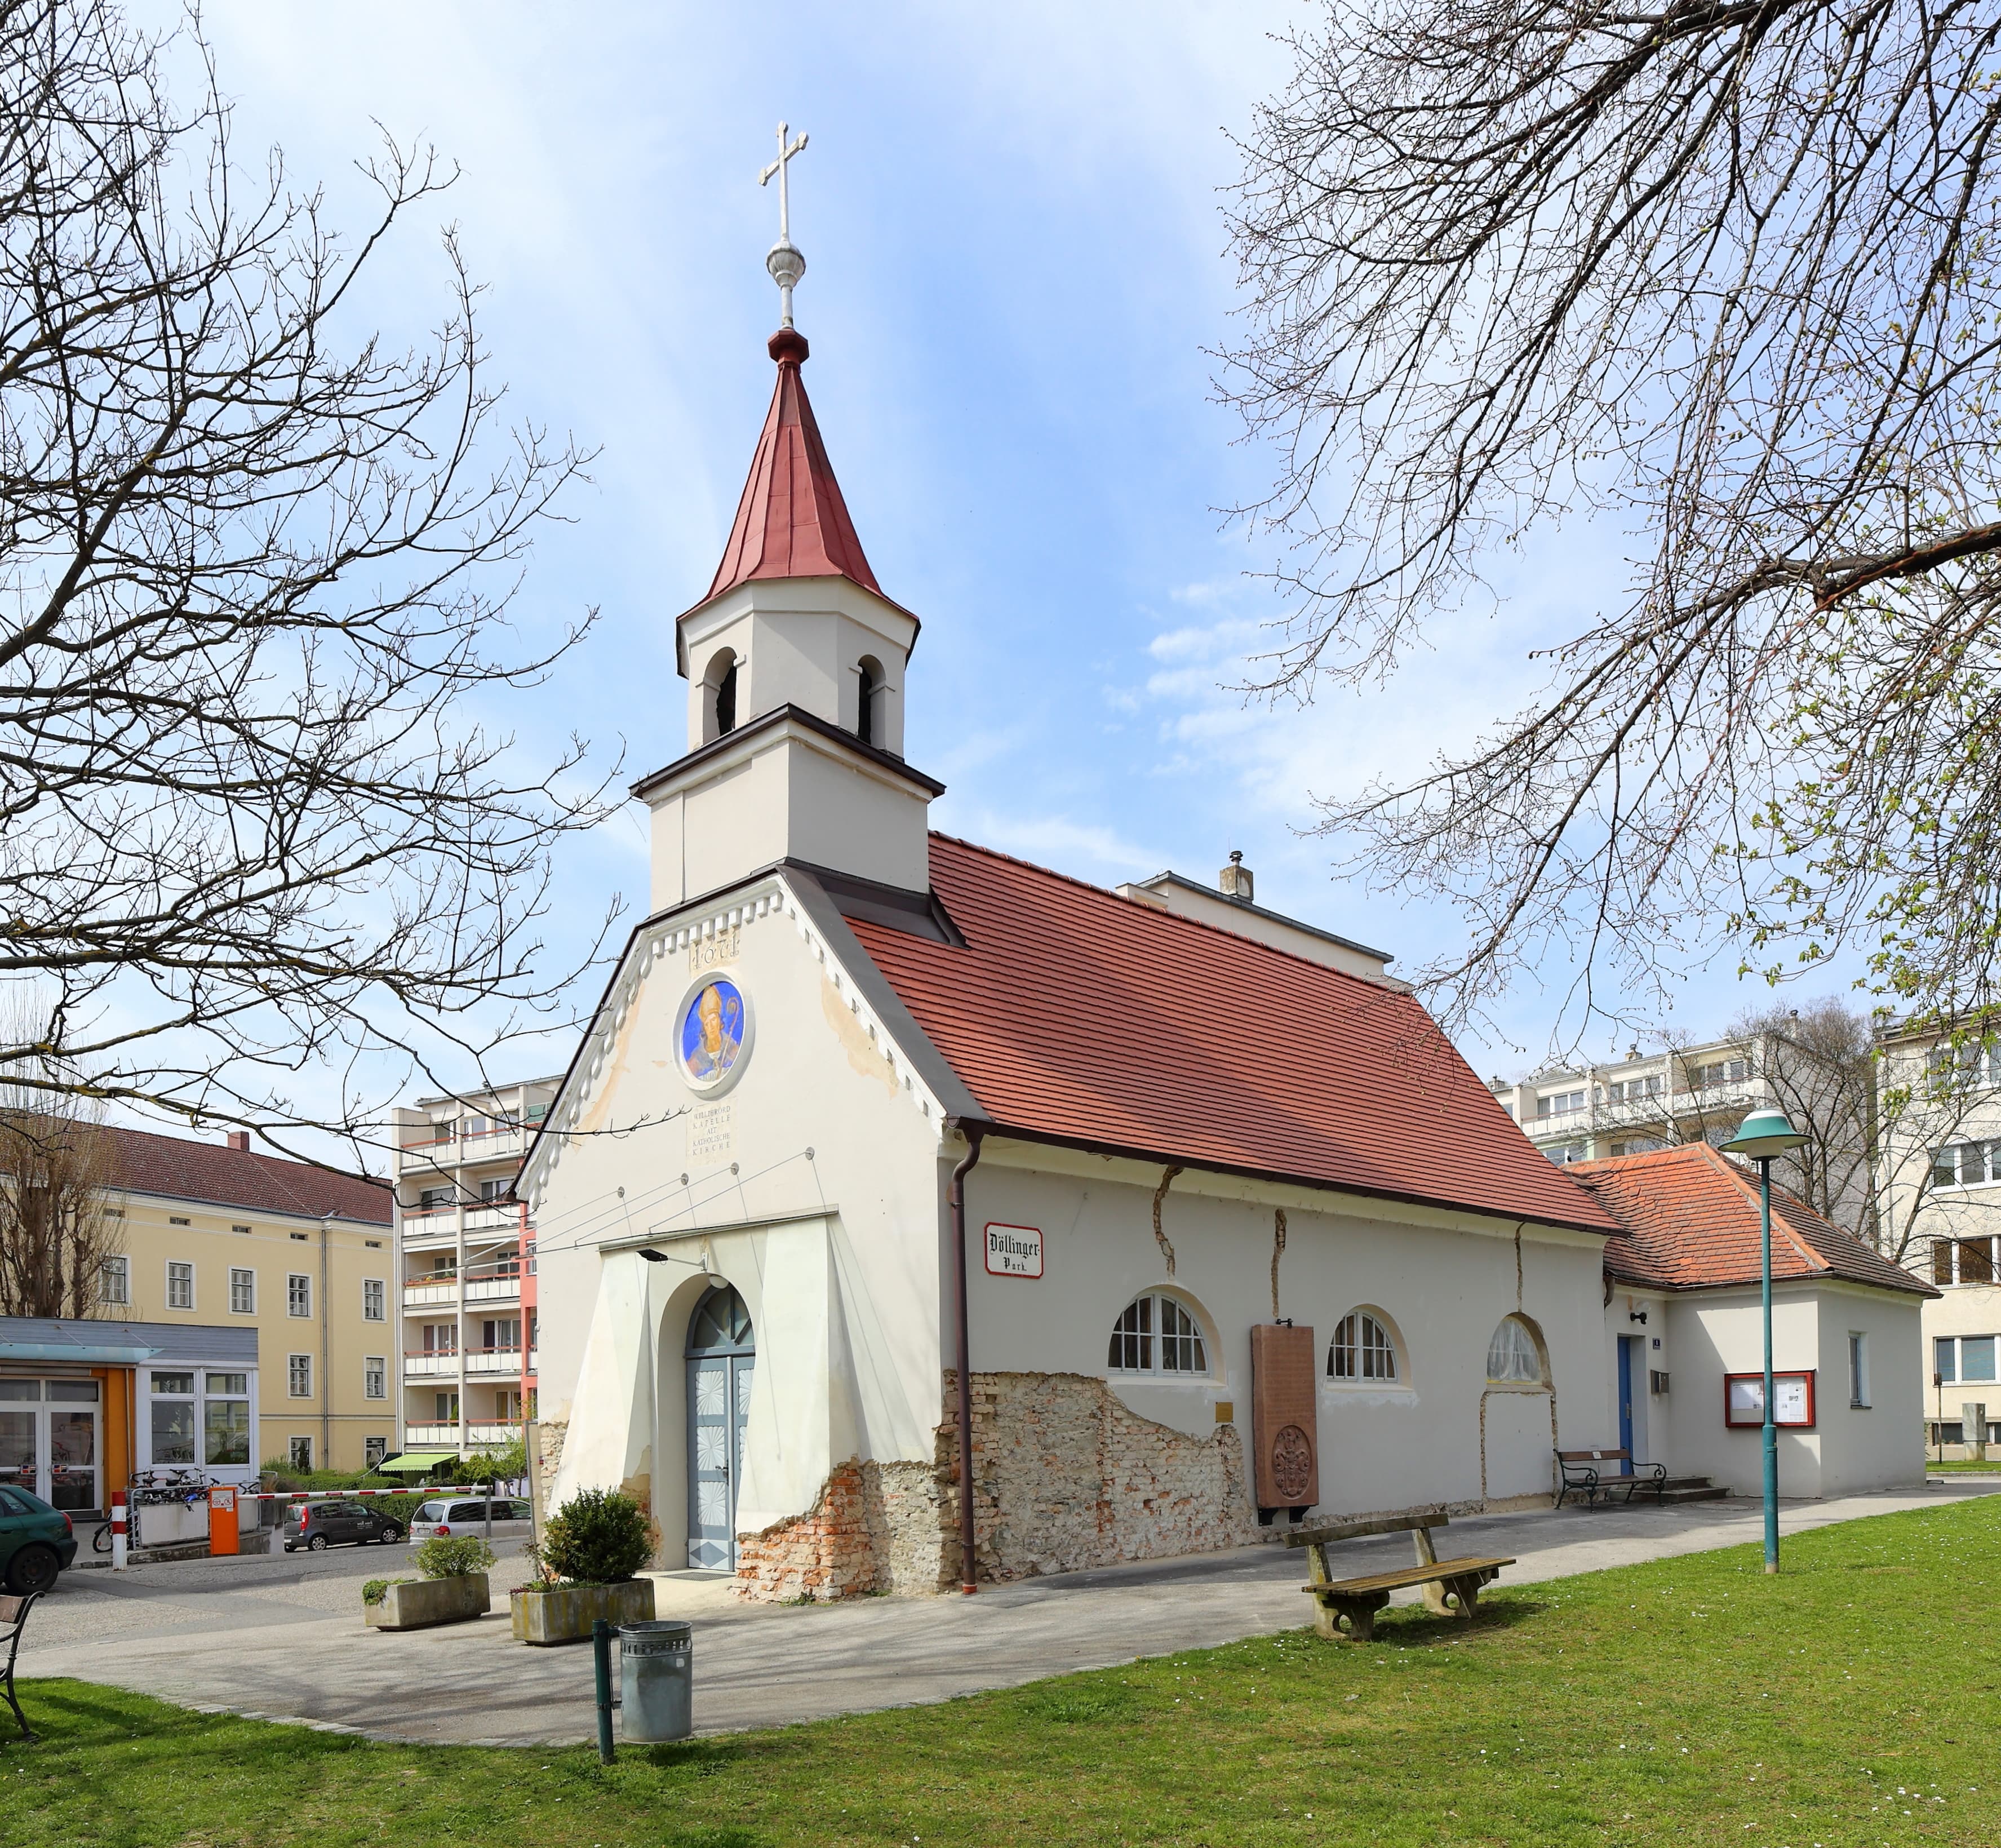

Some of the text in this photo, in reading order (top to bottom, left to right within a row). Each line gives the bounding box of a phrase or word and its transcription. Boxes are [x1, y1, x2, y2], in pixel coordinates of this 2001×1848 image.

[694, 1105, 730, 1120] WILLIBRORD
[693, 1114, 730, 1129] KAPELLE
[707, 1127, 717, 1135] ALT
[693, 1132, 730, 1147] KATHOLISCHE
[693, 1141, 730, 1156] KIRCHE
